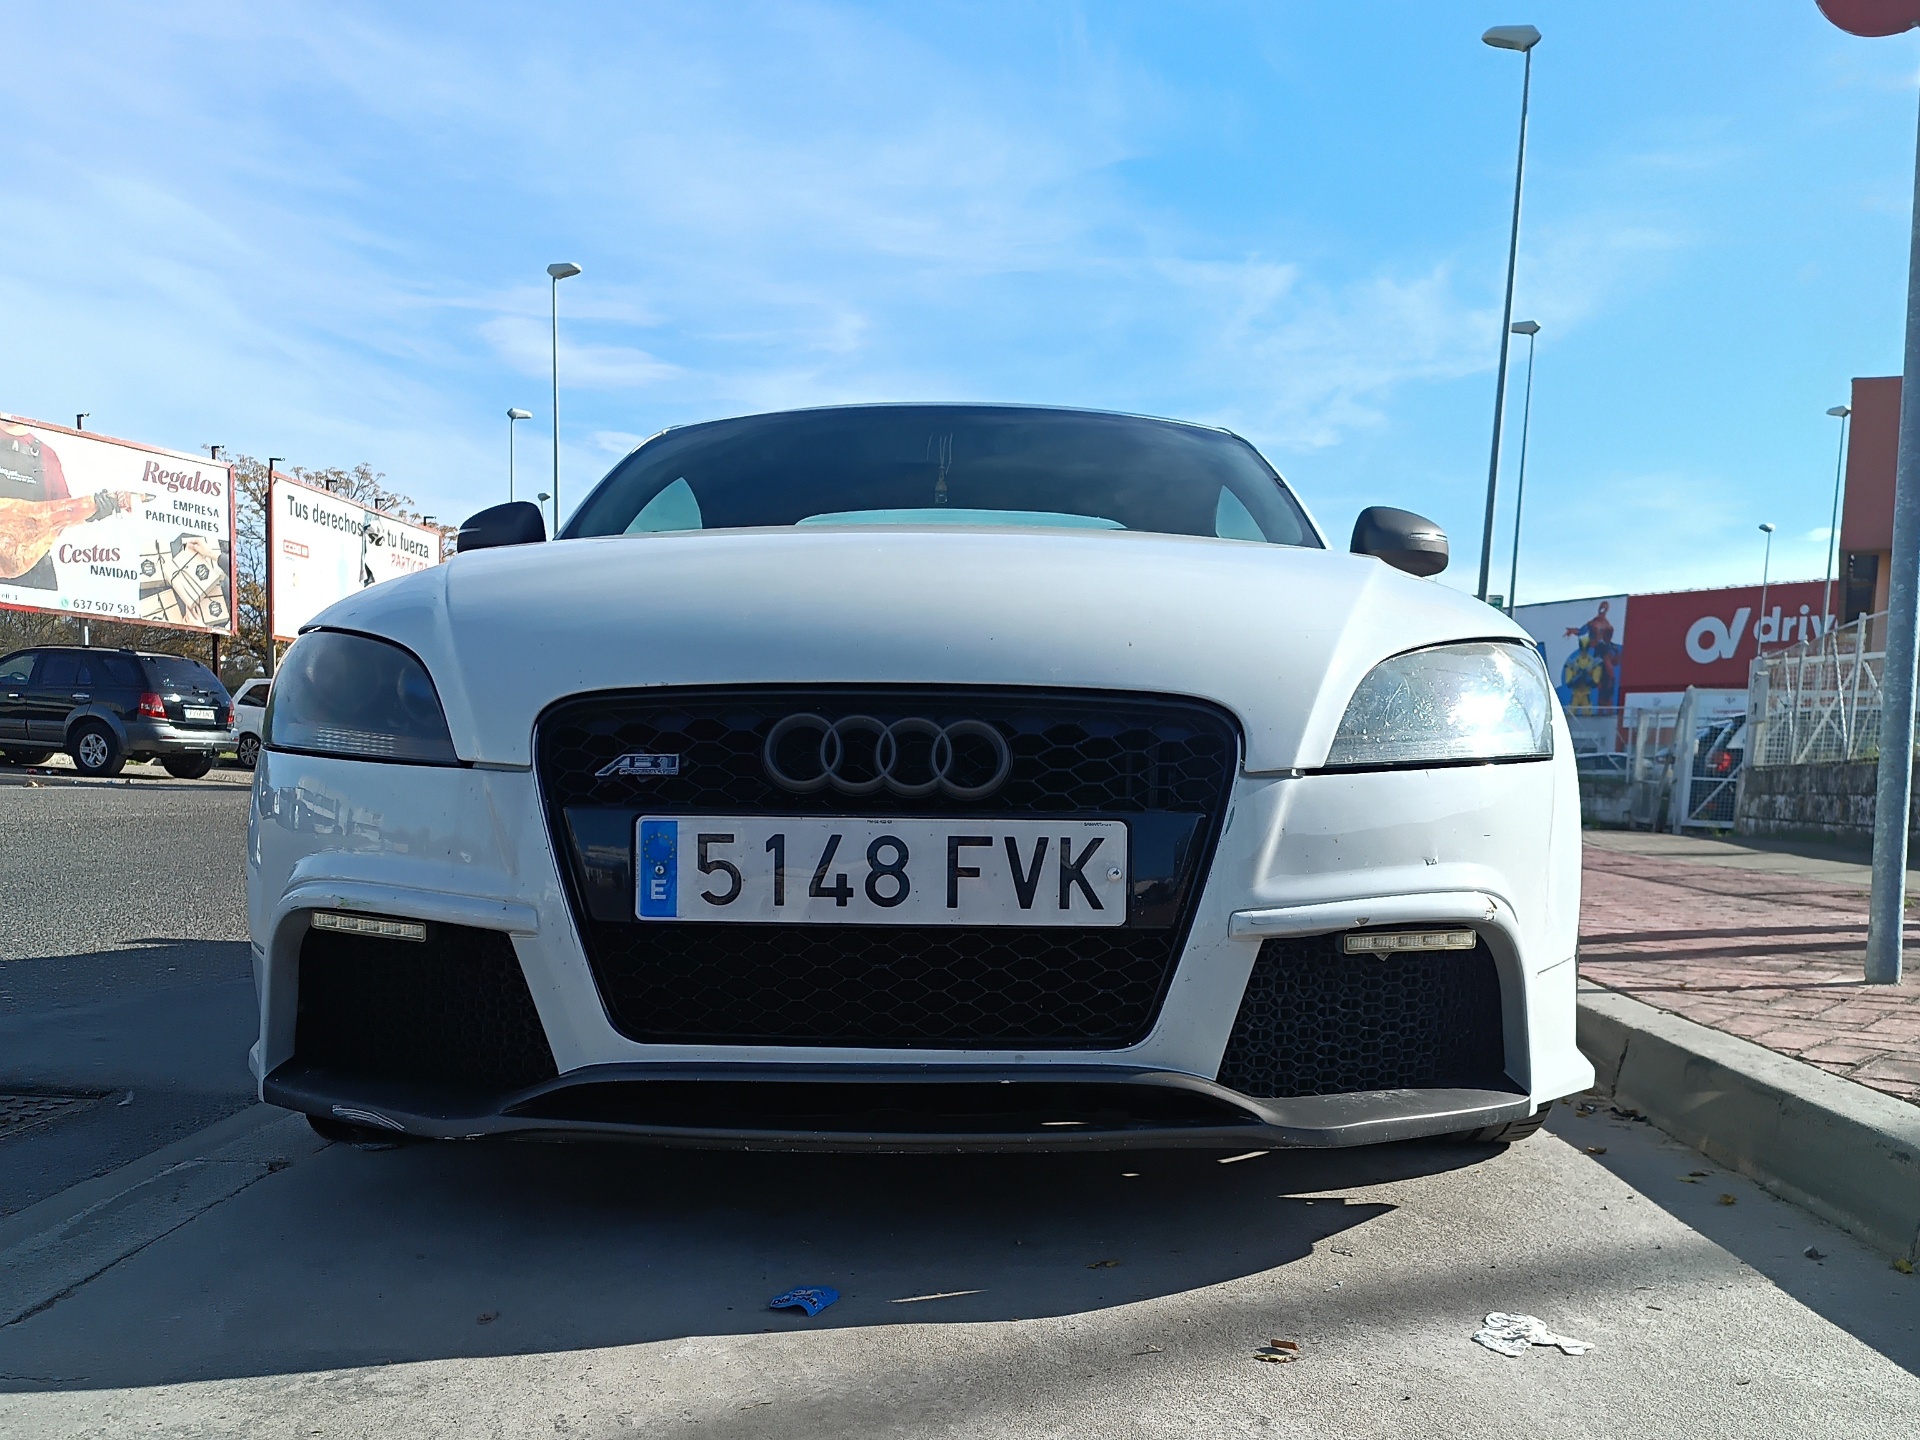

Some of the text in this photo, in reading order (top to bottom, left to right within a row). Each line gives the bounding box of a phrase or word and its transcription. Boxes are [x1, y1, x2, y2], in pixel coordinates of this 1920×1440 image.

[174, 500, 219, 518] EMPRESA
[145, 510, 219, 533] PARTICULARES
[287, 494, 309, 521] Tus
[387, 529, 397, 548] tu
[400, 532, 429, 559] fuerza
[90, 565, 138, 580] NAVIDAD
[73, 599, 136, 615] 637 507 583
[1753, 604, 1839, 643] driv
[650, 879, 668, 900] E
[697, 833, 911, 908] 5148
[946, 835, 1106, 910] FVK
